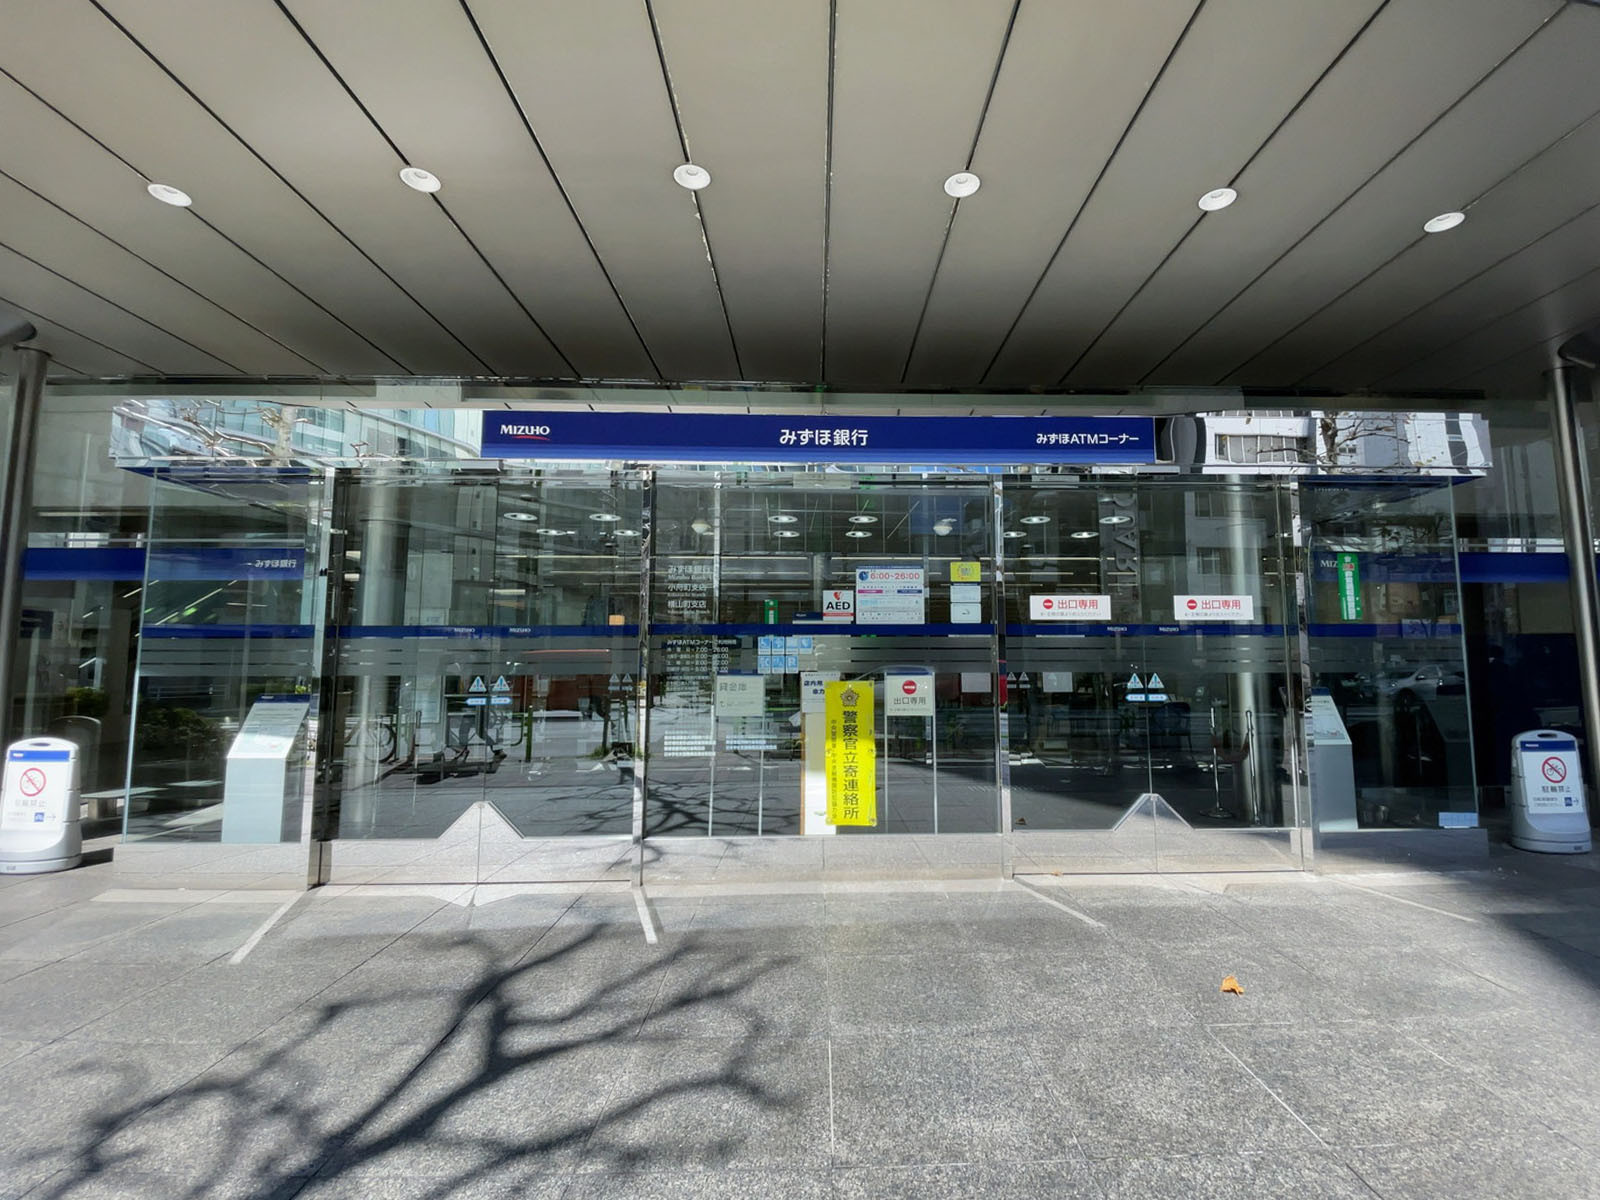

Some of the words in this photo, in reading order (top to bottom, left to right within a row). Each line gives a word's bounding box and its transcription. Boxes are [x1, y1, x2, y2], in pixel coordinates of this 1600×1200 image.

[500, 424, 550, 435] MIZUHO
[780, 428, 868, 446] みずほ銀行
[1036, 433, 1139, 444] みずほATMコーナー
[826, 602, 851, 610] AED
[1058, 600, 1098, 609] 出口専用
[1201, 600, 1241, 609] 出口専用
[894, 697, 926, 705] 出口専用
[843, 711, 859, 819] 警察官立寄連絡所
